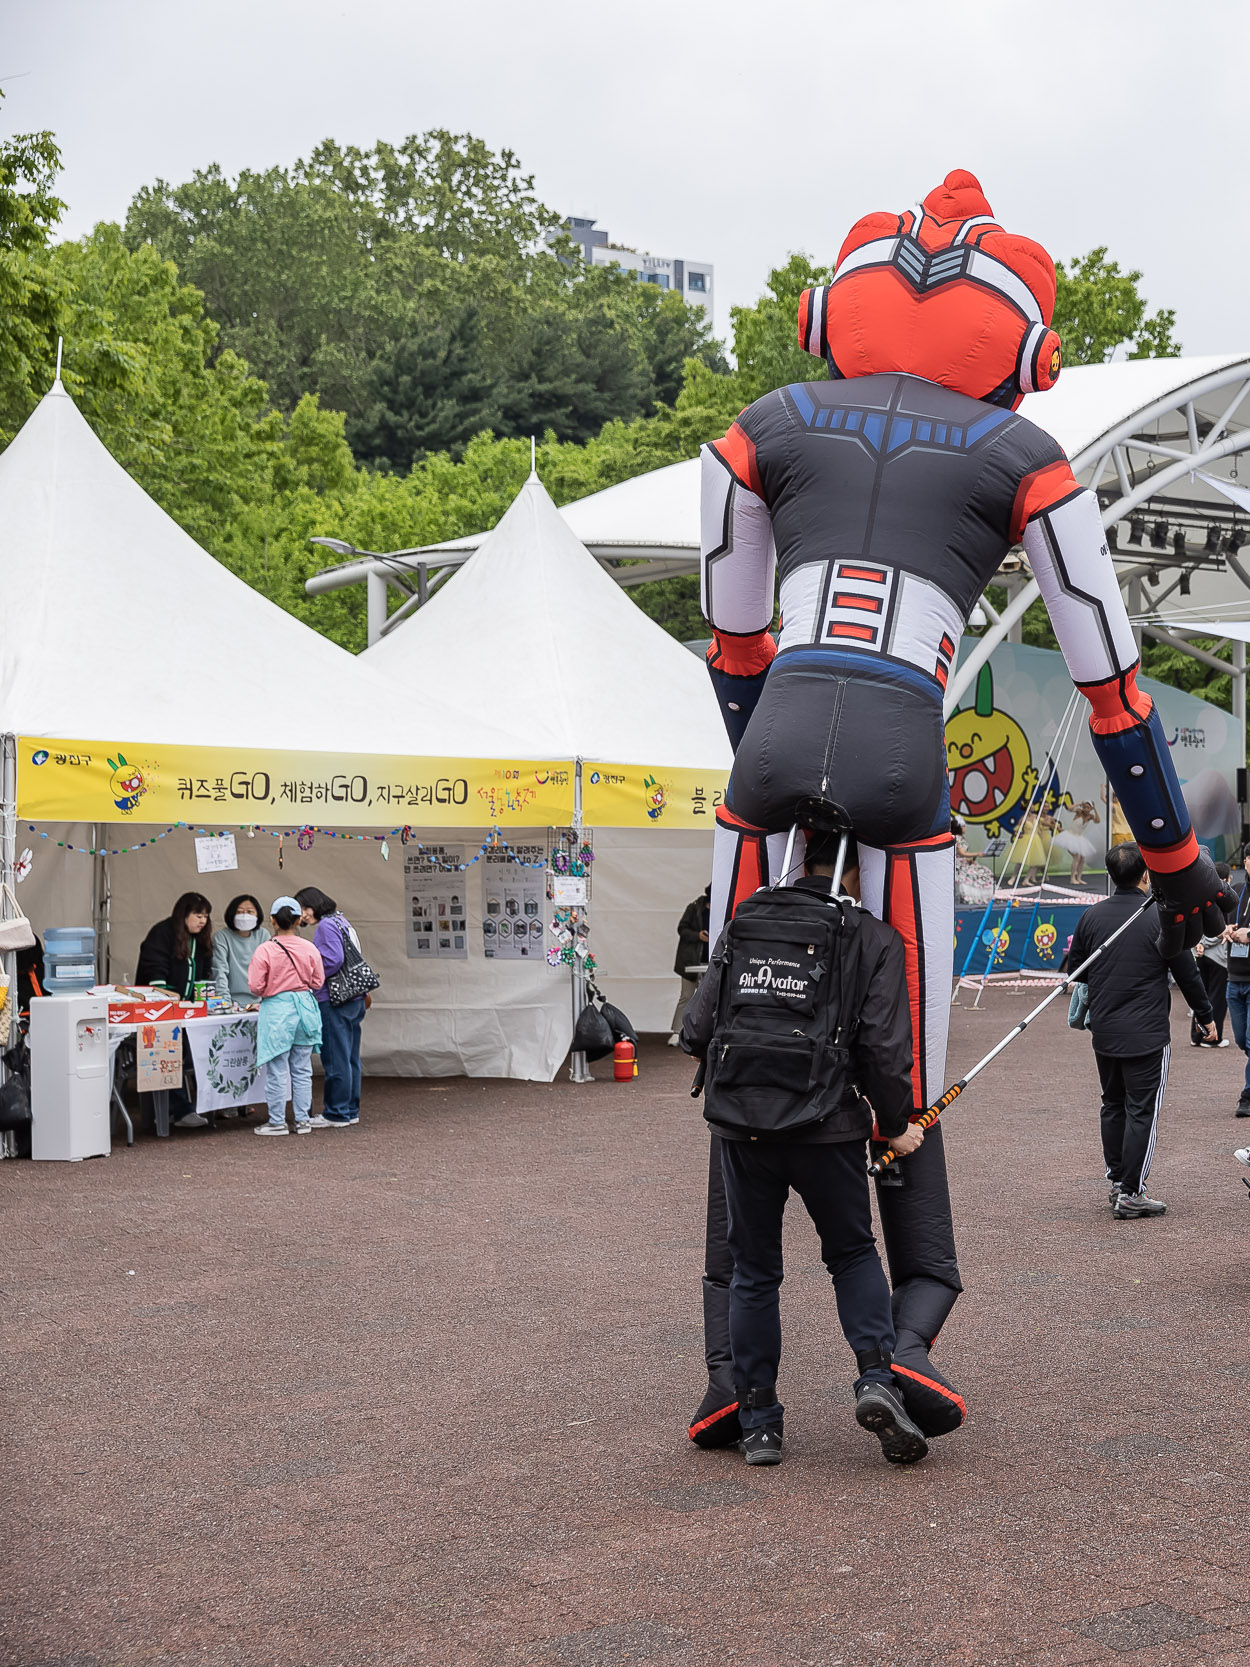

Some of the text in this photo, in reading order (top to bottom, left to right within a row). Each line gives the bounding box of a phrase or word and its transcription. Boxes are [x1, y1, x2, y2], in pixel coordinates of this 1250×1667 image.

[53, 754, 91, 766] 광진구
[603, 774, 626, 784] 광진구
[177, 771, 468, 807] 퀴즈풀GO, 체험하GO, 지구살리GO
[767, 957, 800, 968] Performance
